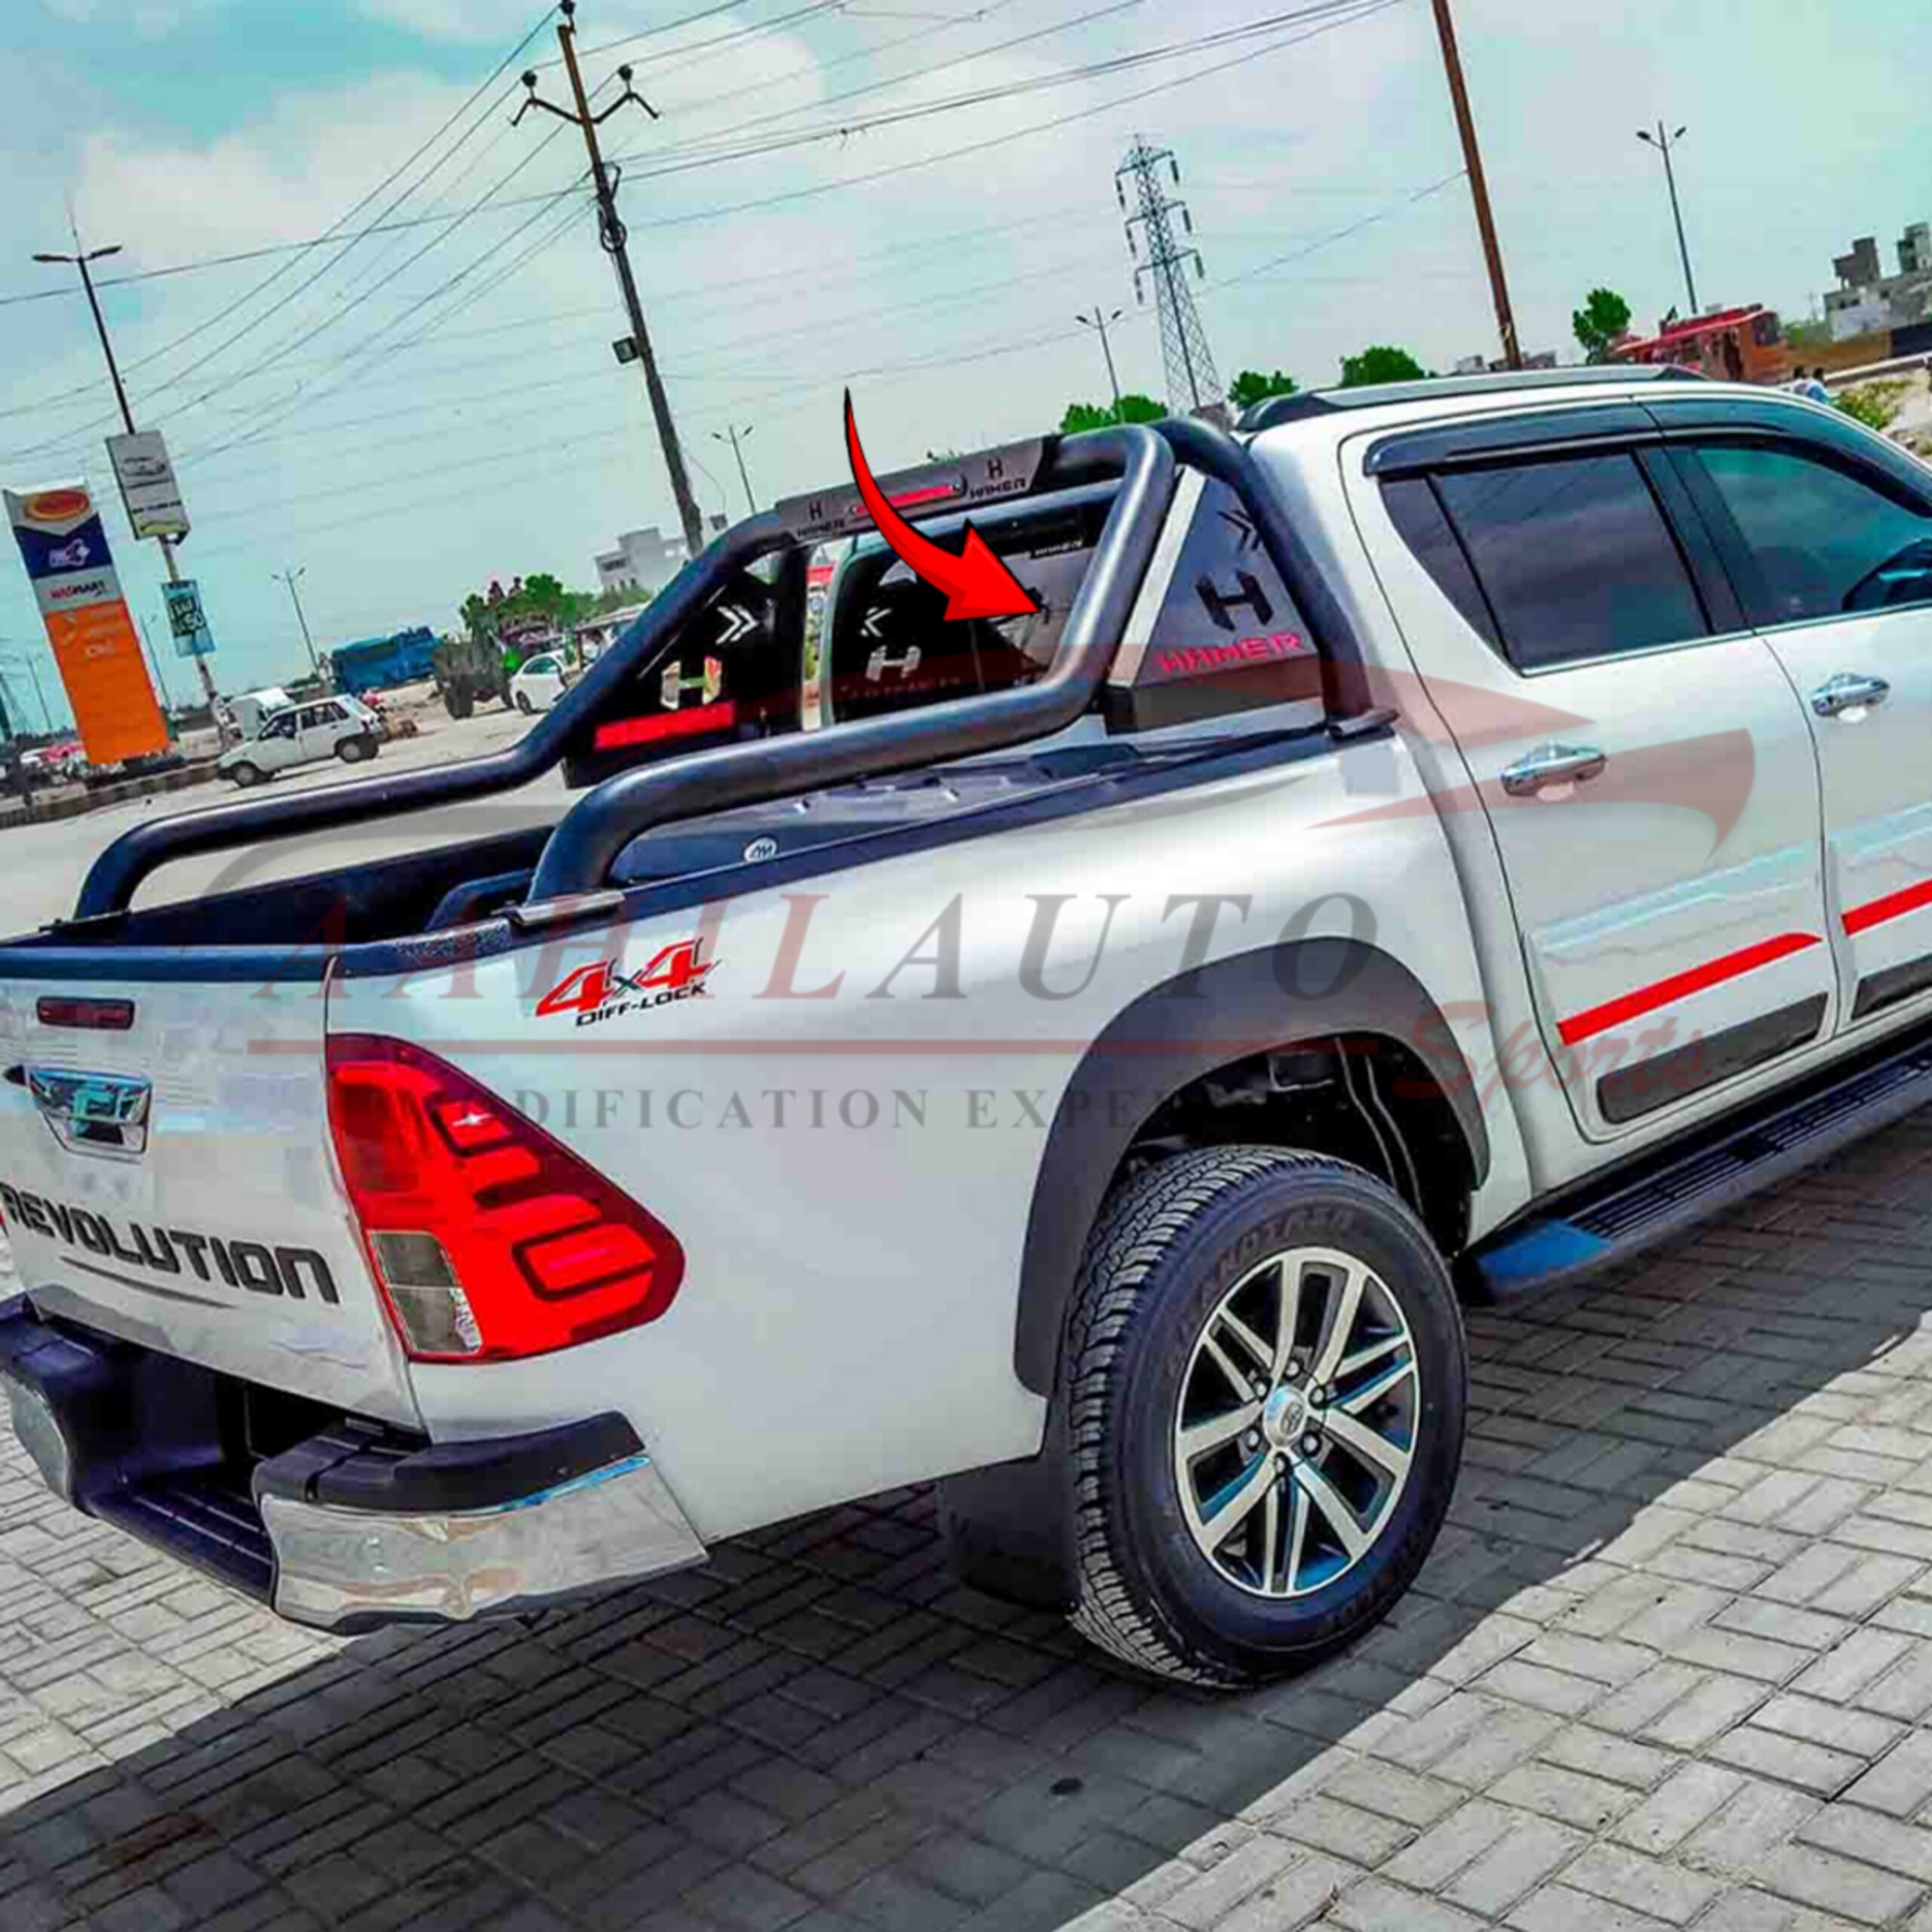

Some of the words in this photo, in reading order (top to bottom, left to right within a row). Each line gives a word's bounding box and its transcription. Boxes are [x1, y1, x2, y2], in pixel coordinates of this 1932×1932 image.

[1154, 631, 1302, 673] HAMER
[575, 980, 706, 1027] DIFF-LOCK
[0, 1182, 340, 1305] REVOLUTION
